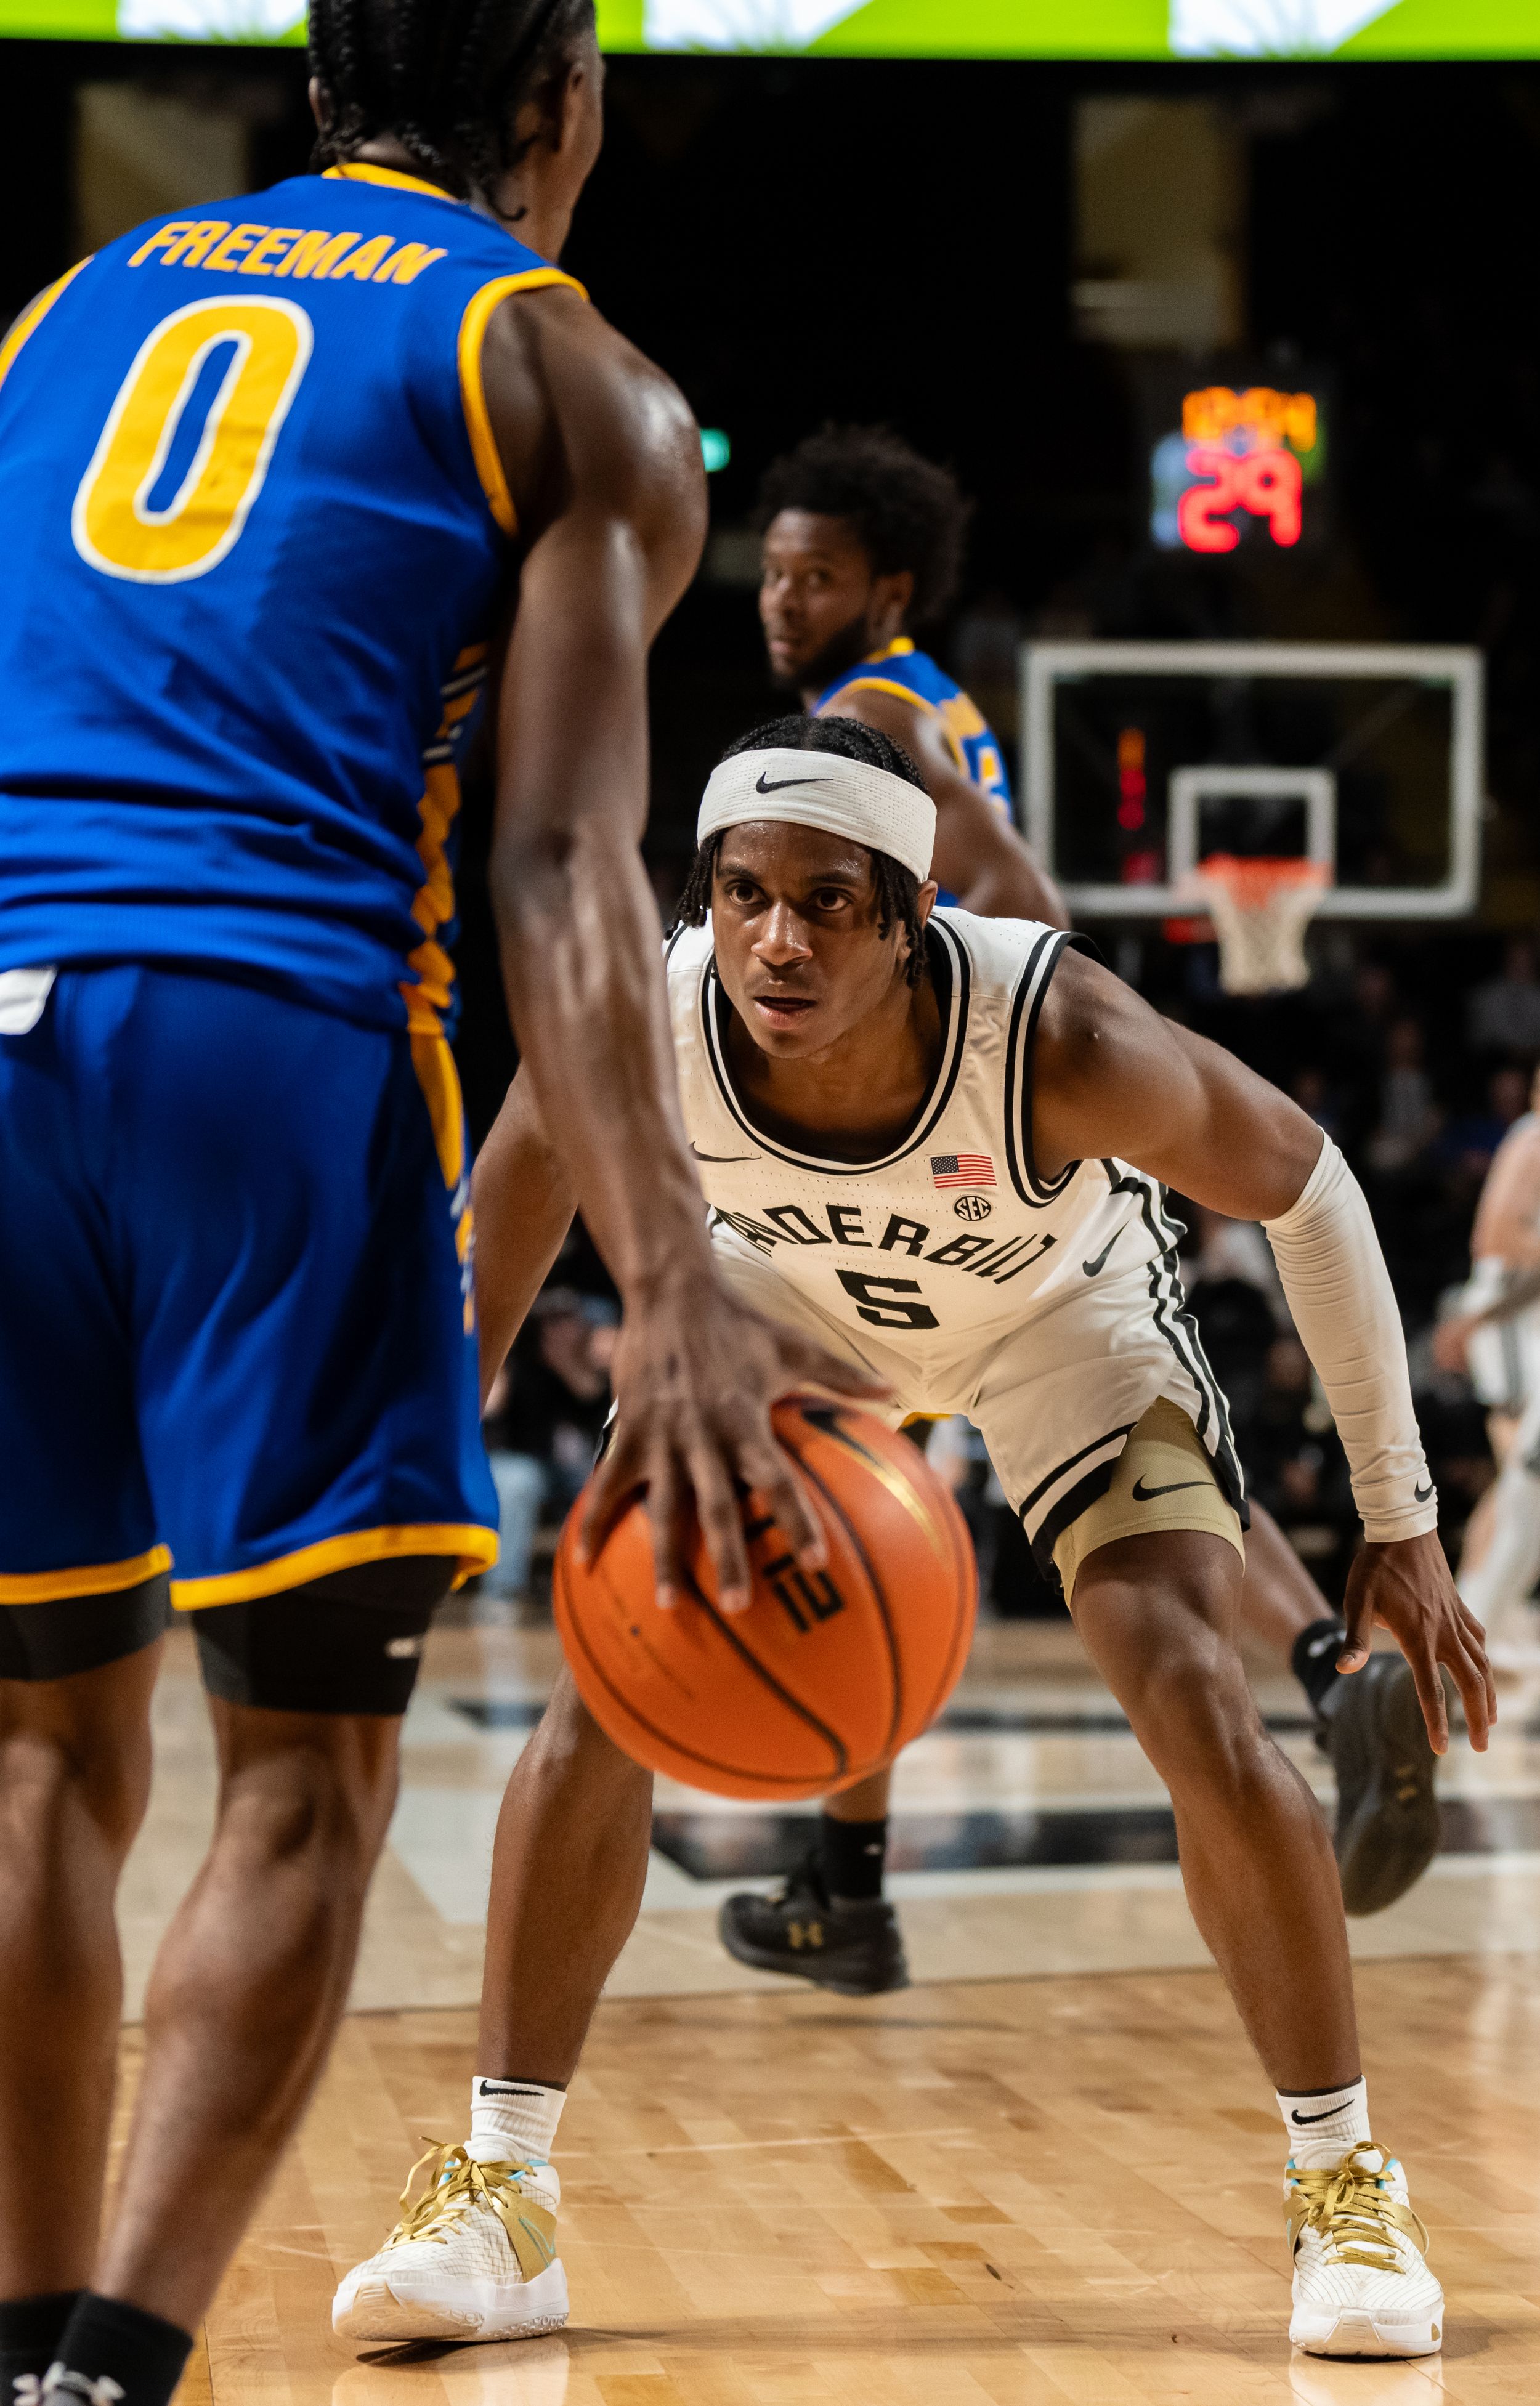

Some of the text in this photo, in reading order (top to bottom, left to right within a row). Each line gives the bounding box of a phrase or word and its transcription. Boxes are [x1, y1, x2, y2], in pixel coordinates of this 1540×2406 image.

[127, 220, 448, 285] FREEMAN
[71, 294, 314, 585] 0
[1178, 448, 1302, 553] 29
[713, 1204, 1058, 1285] ANDERBILT
[956, 1197, 990, 1220] SEC
[835, 1268, 940, 1329] 5
